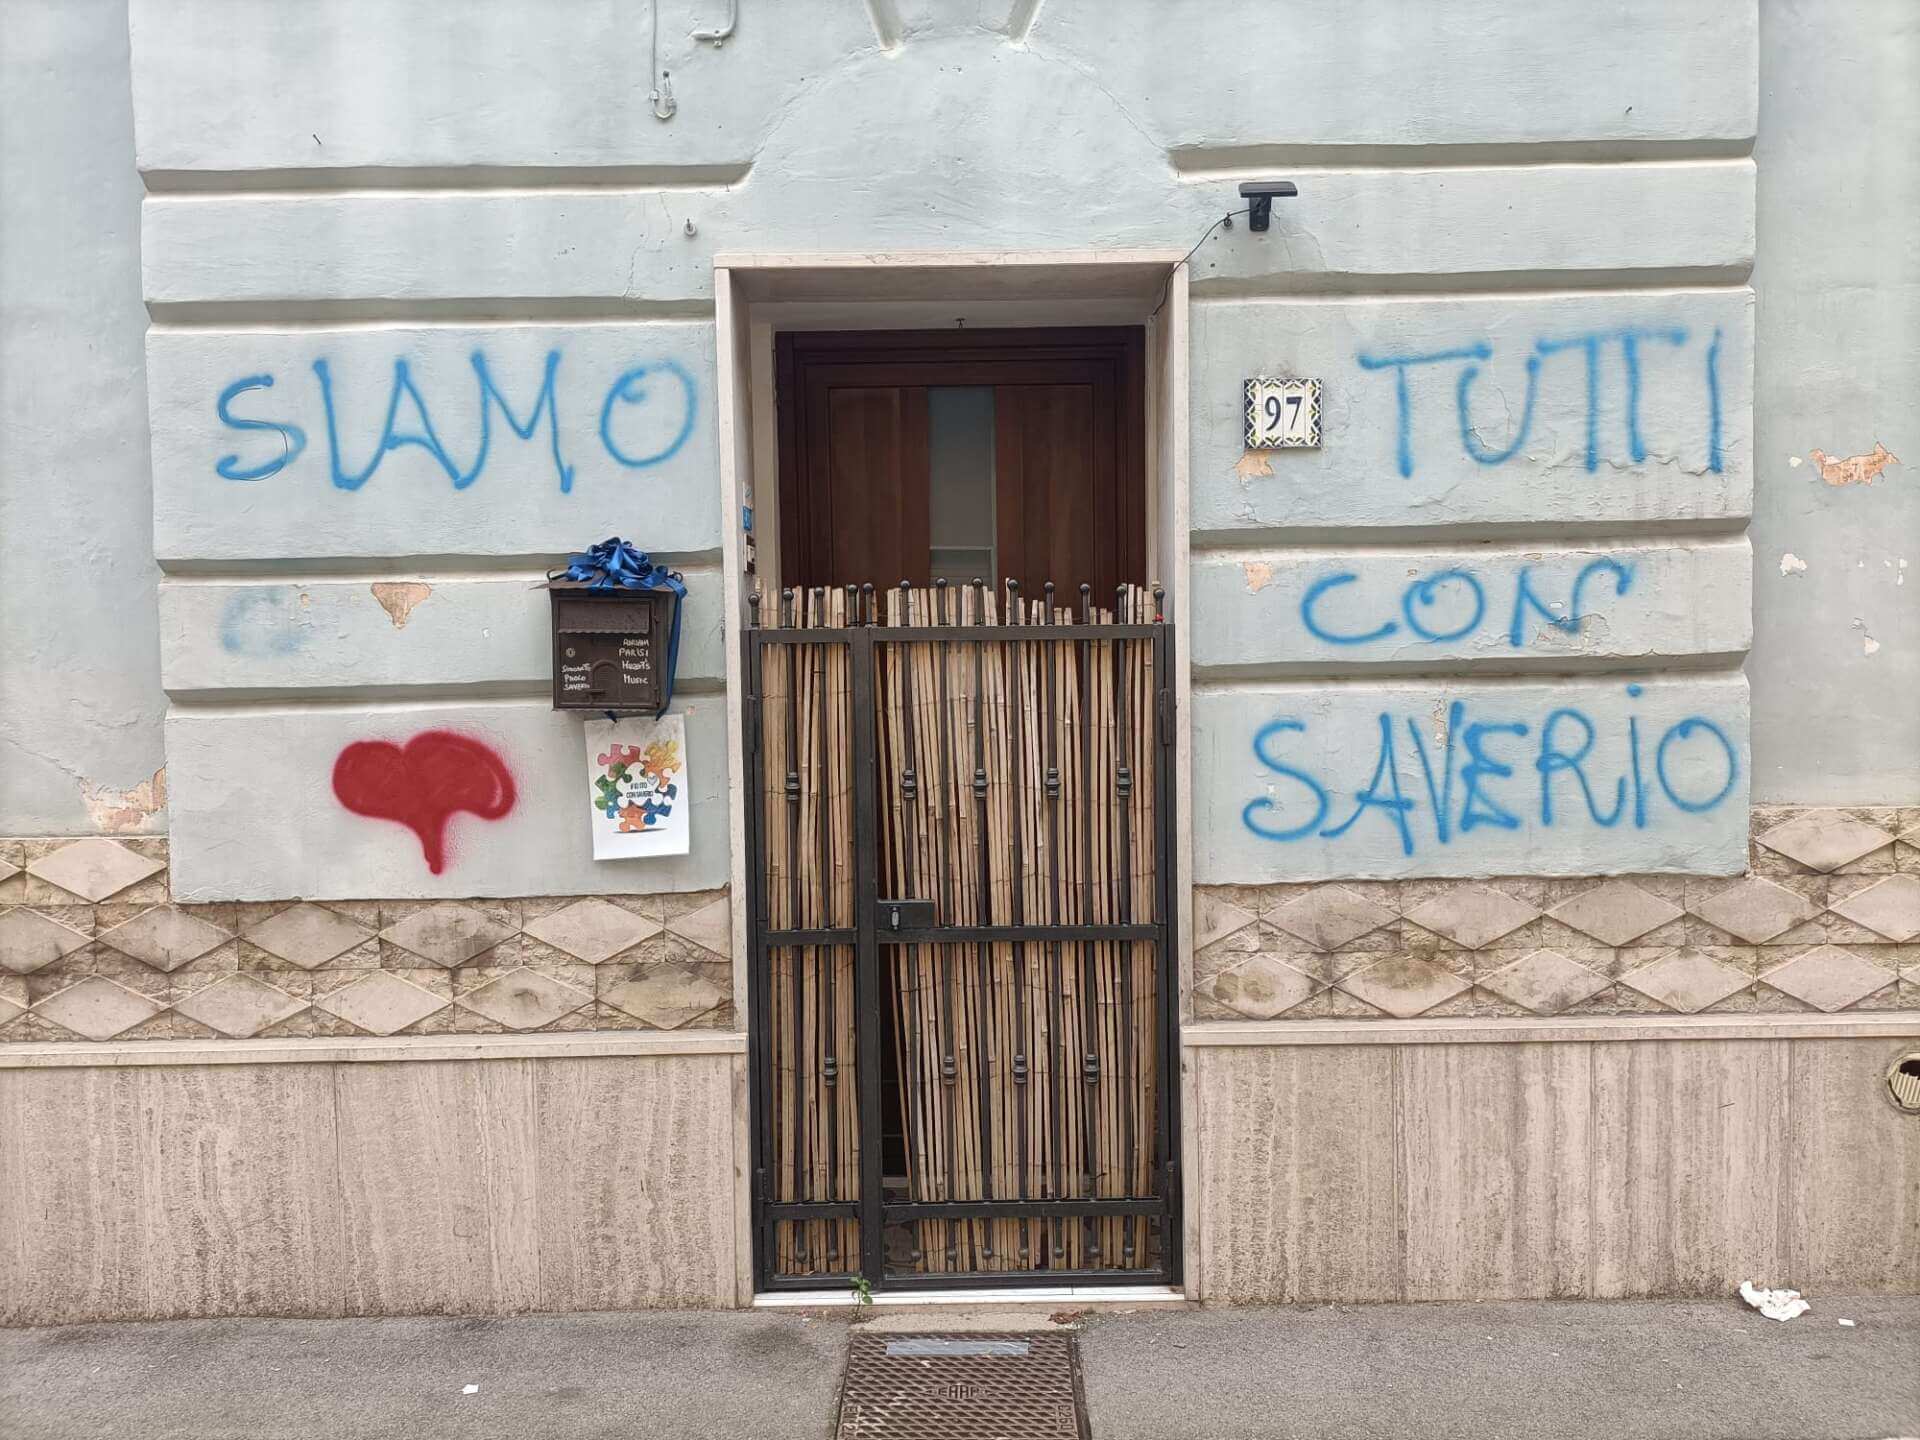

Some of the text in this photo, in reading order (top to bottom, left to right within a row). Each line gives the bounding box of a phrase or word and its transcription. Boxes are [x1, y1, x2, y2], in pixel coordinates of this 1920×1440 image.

[216, 347, 698, 493] SIAMO
[1265, 396, 1303, 431] 97
[1357, 328, 1723, 478] TUTTI
[1300, 558, 1638, 648] CON
[1242, 684, 1737, 856] SAVERIO
